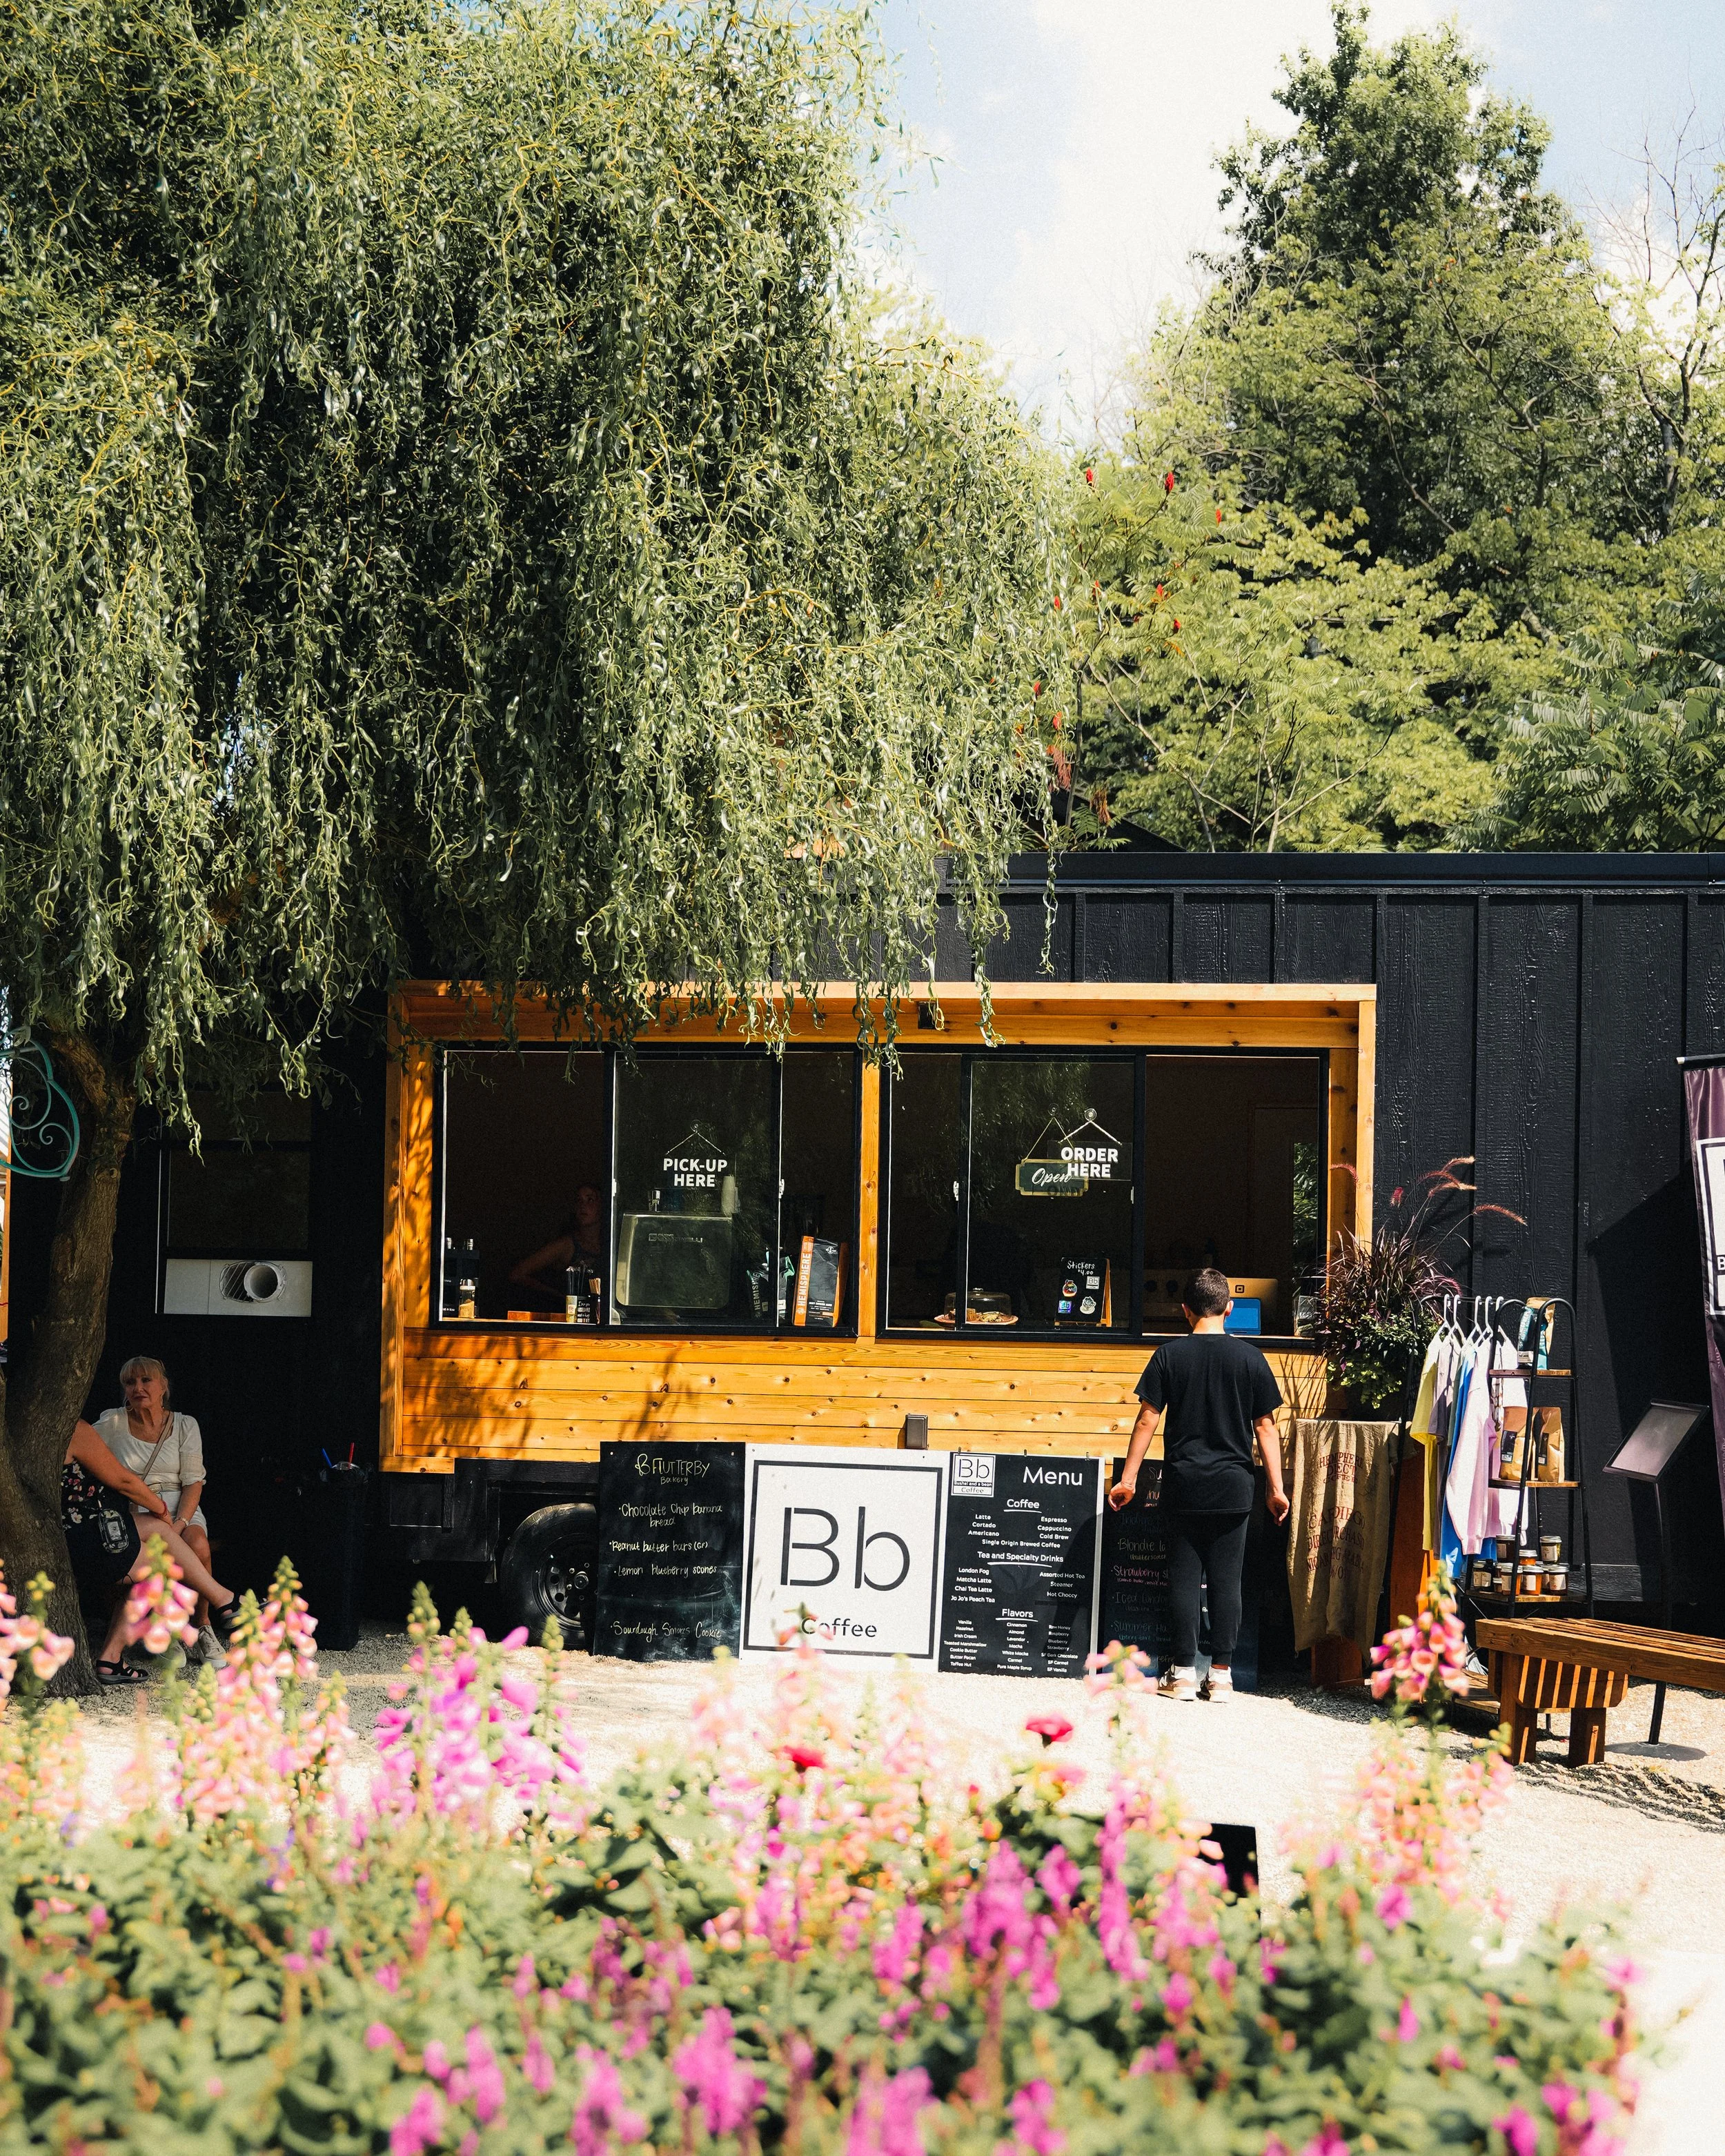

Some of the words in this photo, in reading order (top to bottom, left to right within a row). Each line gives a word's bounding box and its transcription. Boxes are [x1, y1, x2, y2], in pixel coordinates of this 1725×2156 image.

[1061, 1147, 1118, 1163] ORDER
[663, 1158, 728, 1171] PICK-UP
[1067, 1163, 1111, 1178] HERE
[674, 1174, 716, 1187] HERE
[1032, 1167, 1073, 1187] Open
[1067, 1260, 1096, 1269] Stickers
[797, 1253, 811, 1306] HEMISPHERE
[958, 1458, 989, 1478] Bb
[1023, 1465, 1083, 1485] Menu
[660, 1476, 689, 1485] Bakery
[621, 1503, 667, 1517] Chocolate
[693, 1502, 722, 1516] banana
[1007, 1499, 1040, 1509] Coffee
[650, 1516, 676, 1527] bread
[612, 1540, 640, 1551] Peanut
[642, 1541, 669, 1552] butter
[673, 1540, 692, 1551] bars
[693, 1541, 708, 1551] (GF)
[780, 1505, 910, 1592] Bb
[1119, 1538, 1155, 1552] Blondie
[1006, 1553, 1039, 1562] Specialty
[618, 1565, 643, 1576] Lemon
[651, 1563, 689, 1579] blueberry
[693, 1565, 718, 1574] scones
[1113, 1565, 1160, 1582] Strawberry
[1002, 1608, 1034, 1618] Flavors
[613, 1621, 658, 1643] Sourdough
[801, 1616, 878, 1639] Coffee
